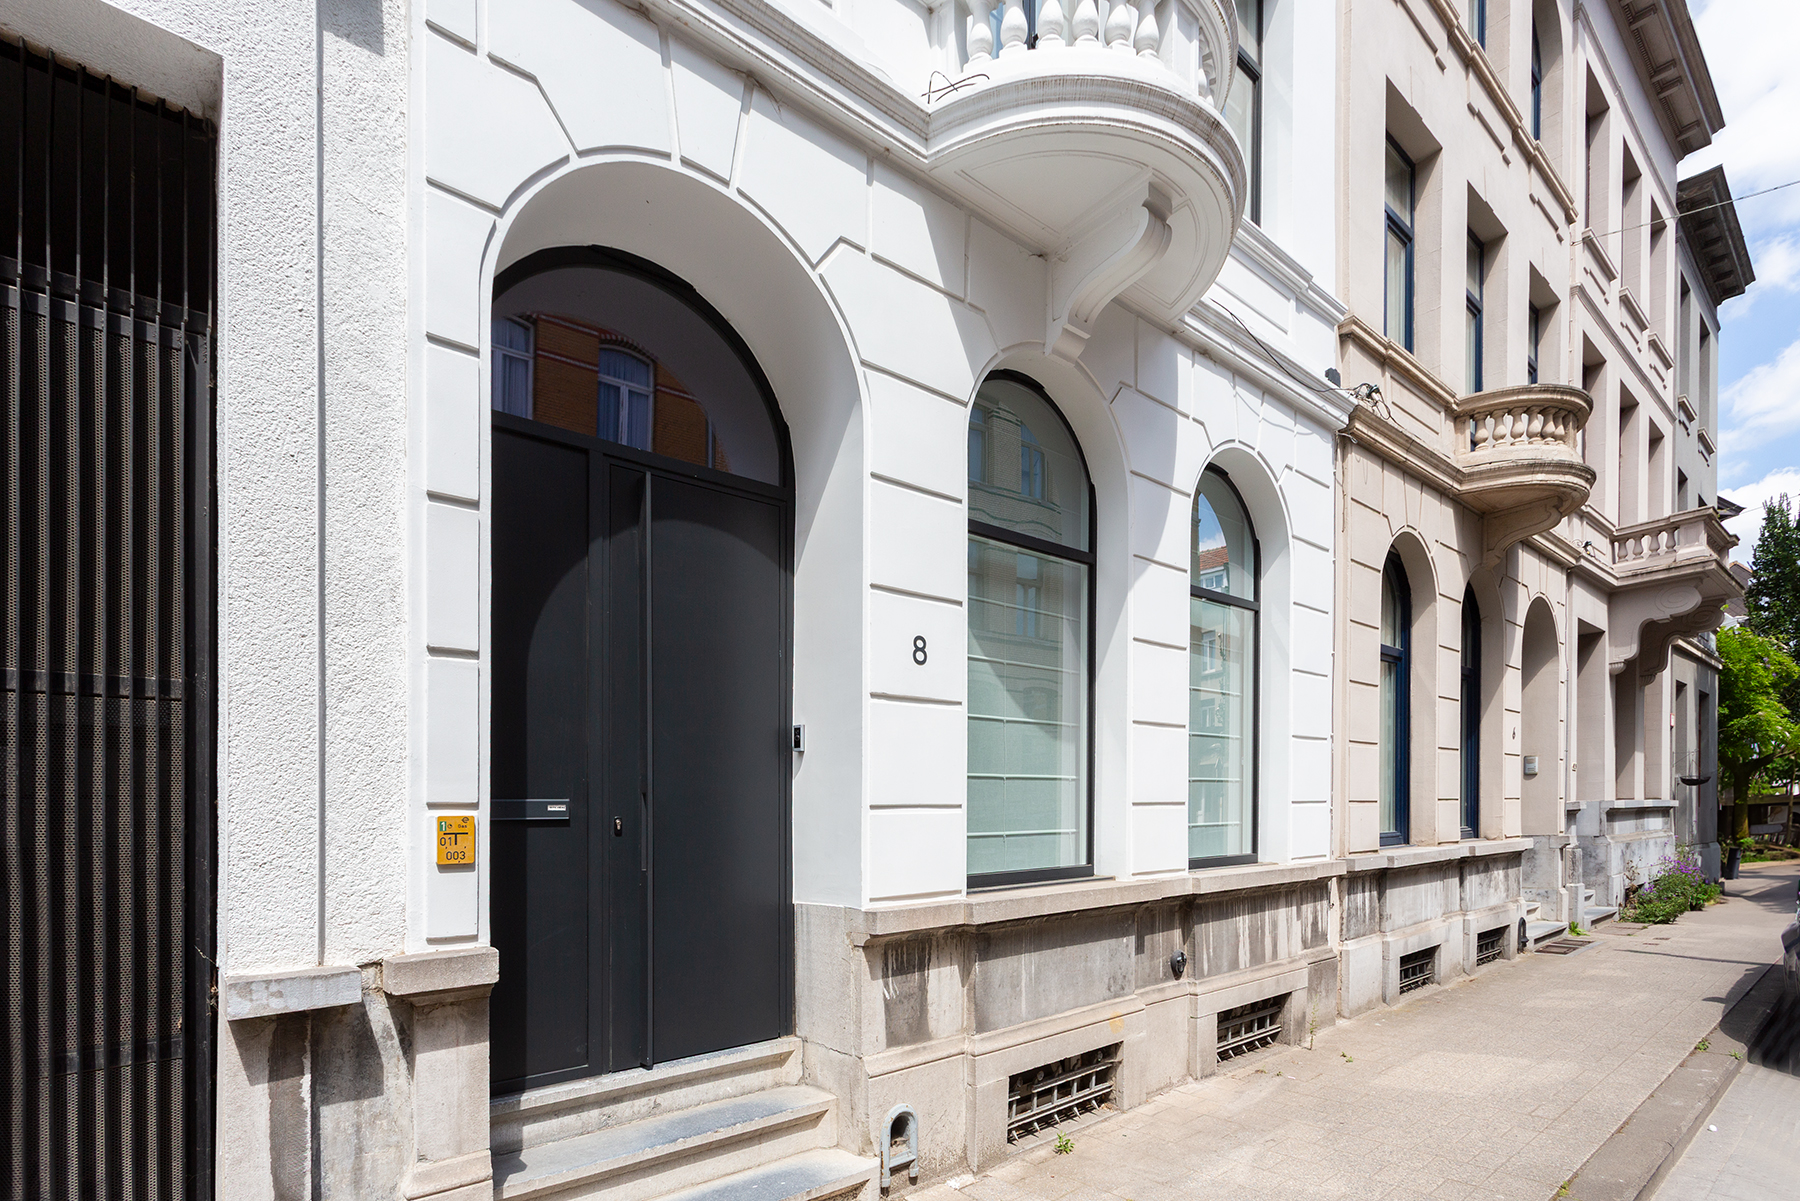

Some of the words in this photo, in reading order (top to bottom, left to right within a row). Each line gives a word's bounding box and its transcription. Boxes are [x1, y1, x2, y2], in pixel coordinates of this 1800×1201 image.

[913, 635, 927, 665] 8
[441, 821, 446, 831] 1
[446, 851, 466, 860] 003
